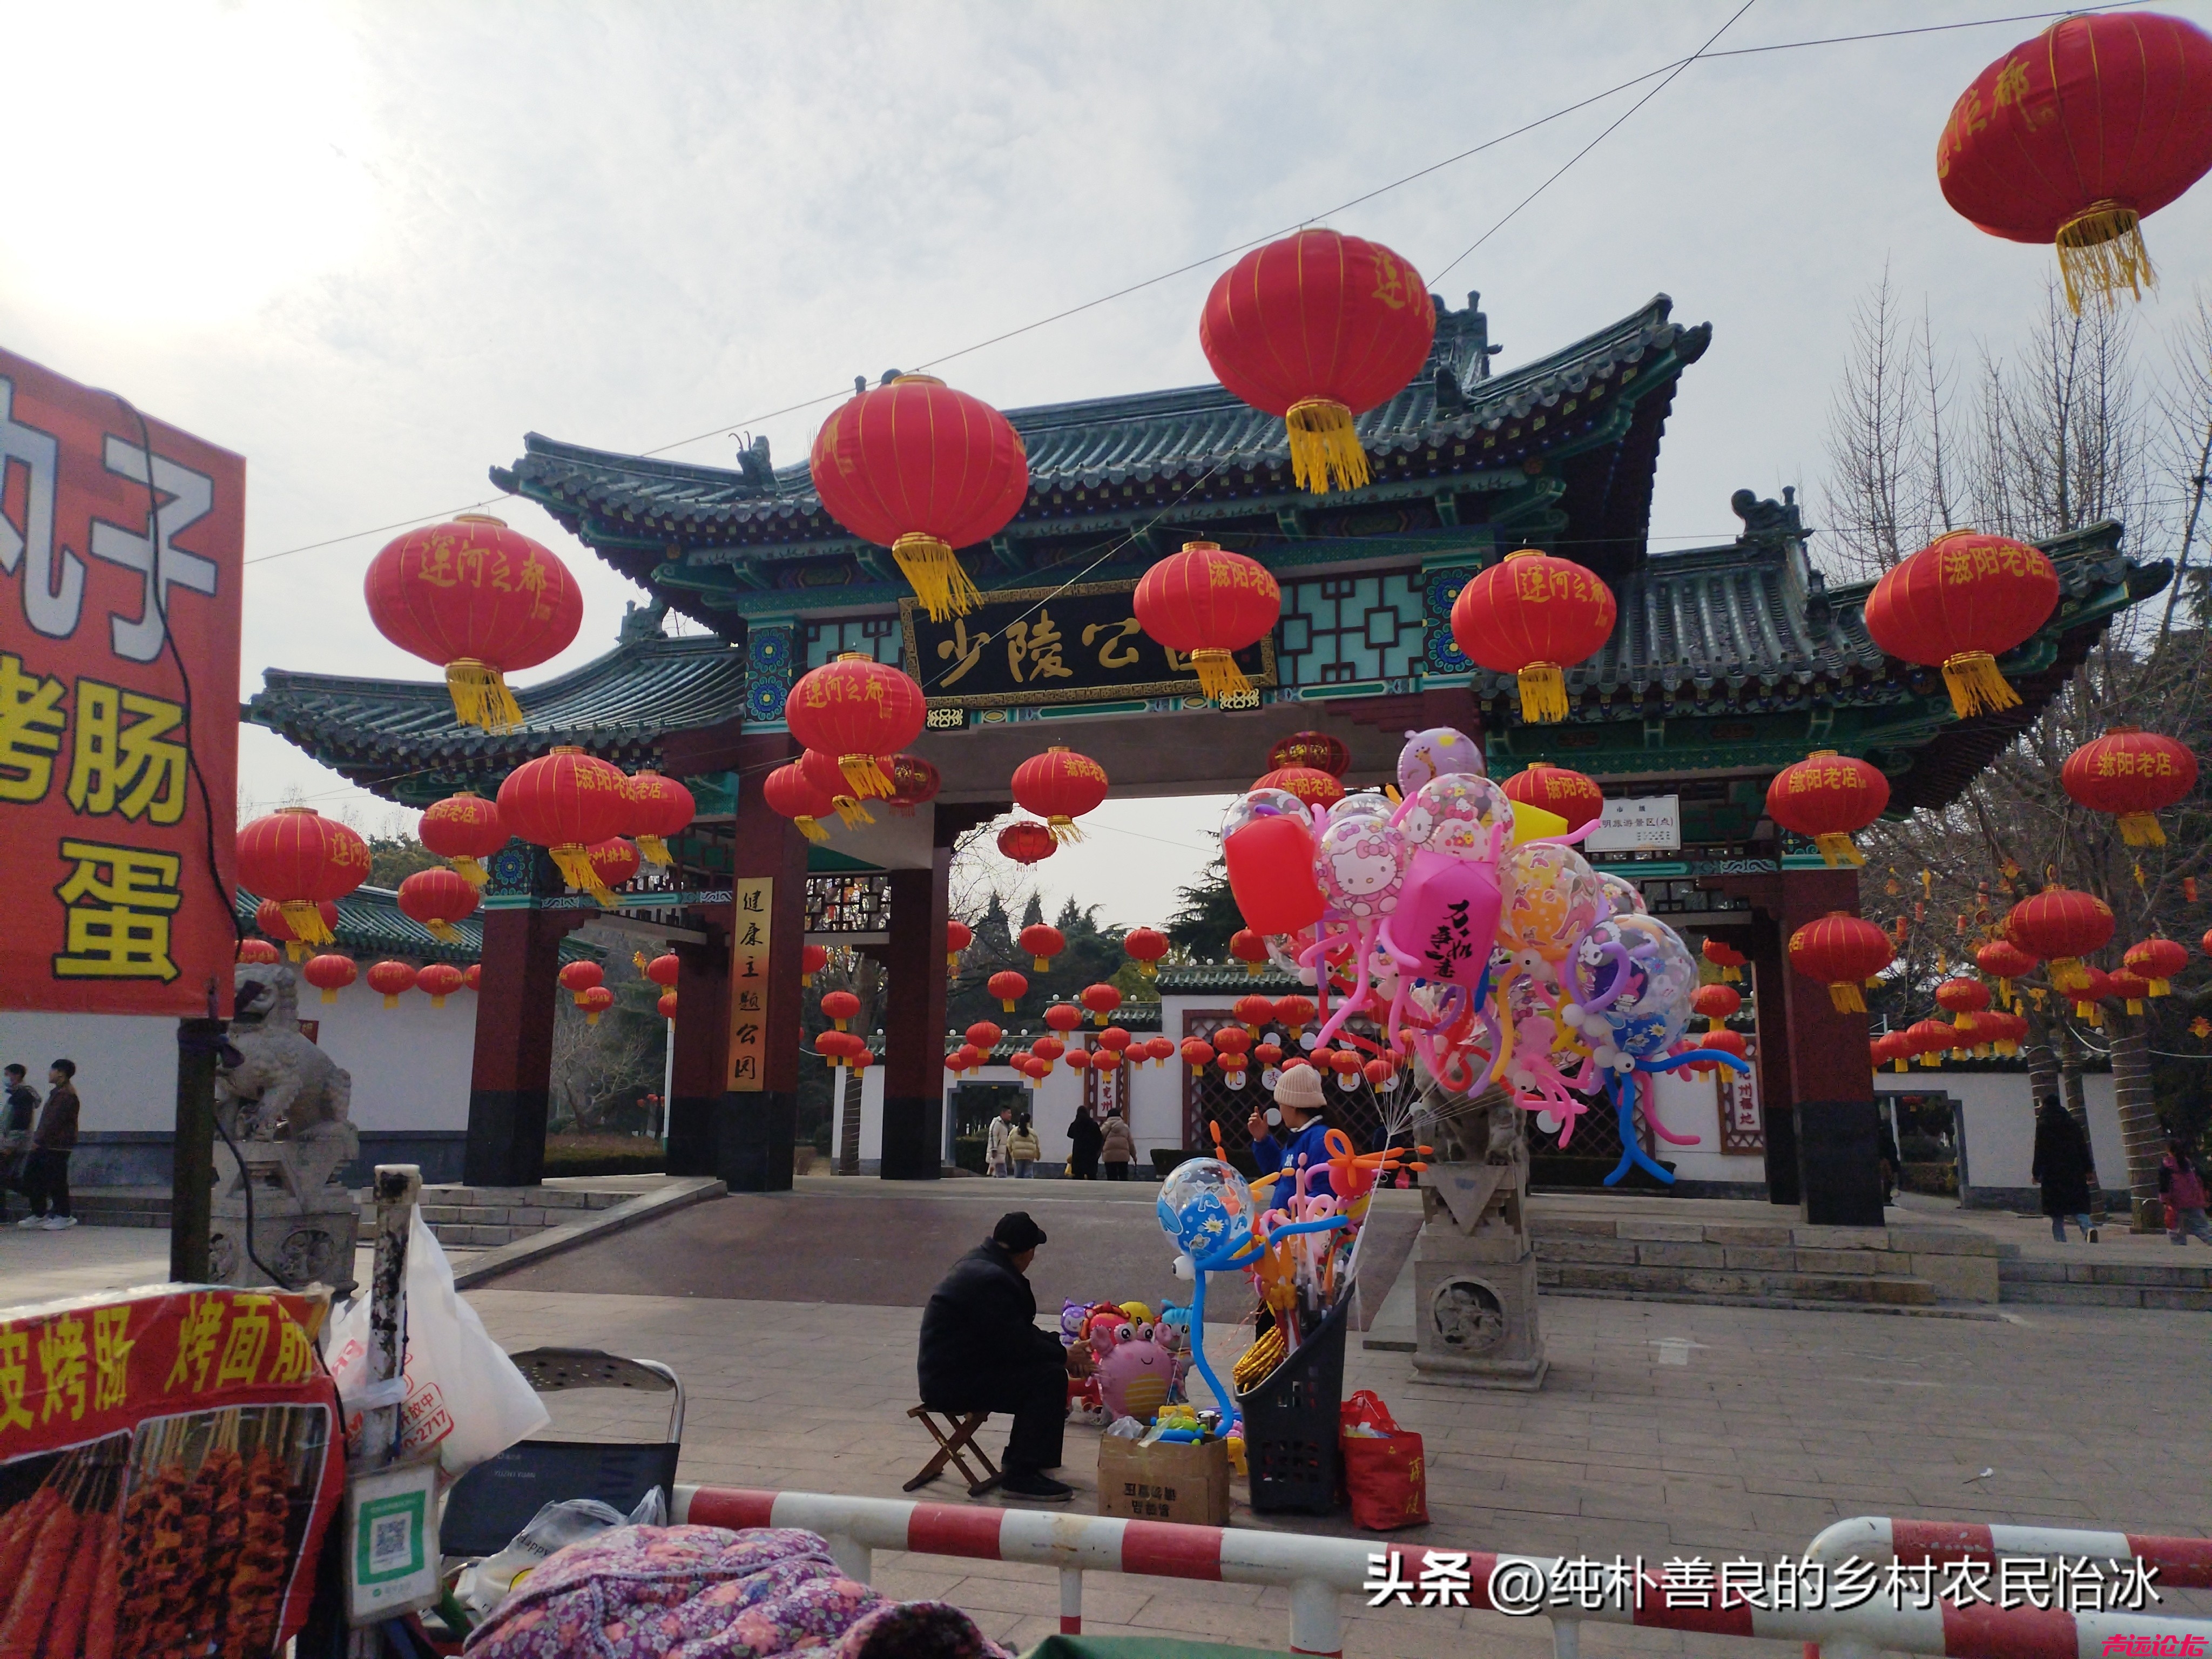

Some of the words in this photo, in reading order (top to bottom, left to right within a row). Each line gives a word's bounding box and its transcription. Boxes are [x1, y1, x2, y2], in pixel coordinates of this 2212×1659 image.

[1944, 543, 2045, 585] 滋阳老店
[938, 609, 1195, 689] 少陵公
[1790, 766, 1860, 793] 滋阳老店
[2099, 751, 2171, 778] 滋阳老店
[1599, 817, 1674, 828] 明旅游景区(点)
[53, 838, 181, 984] 蛋
